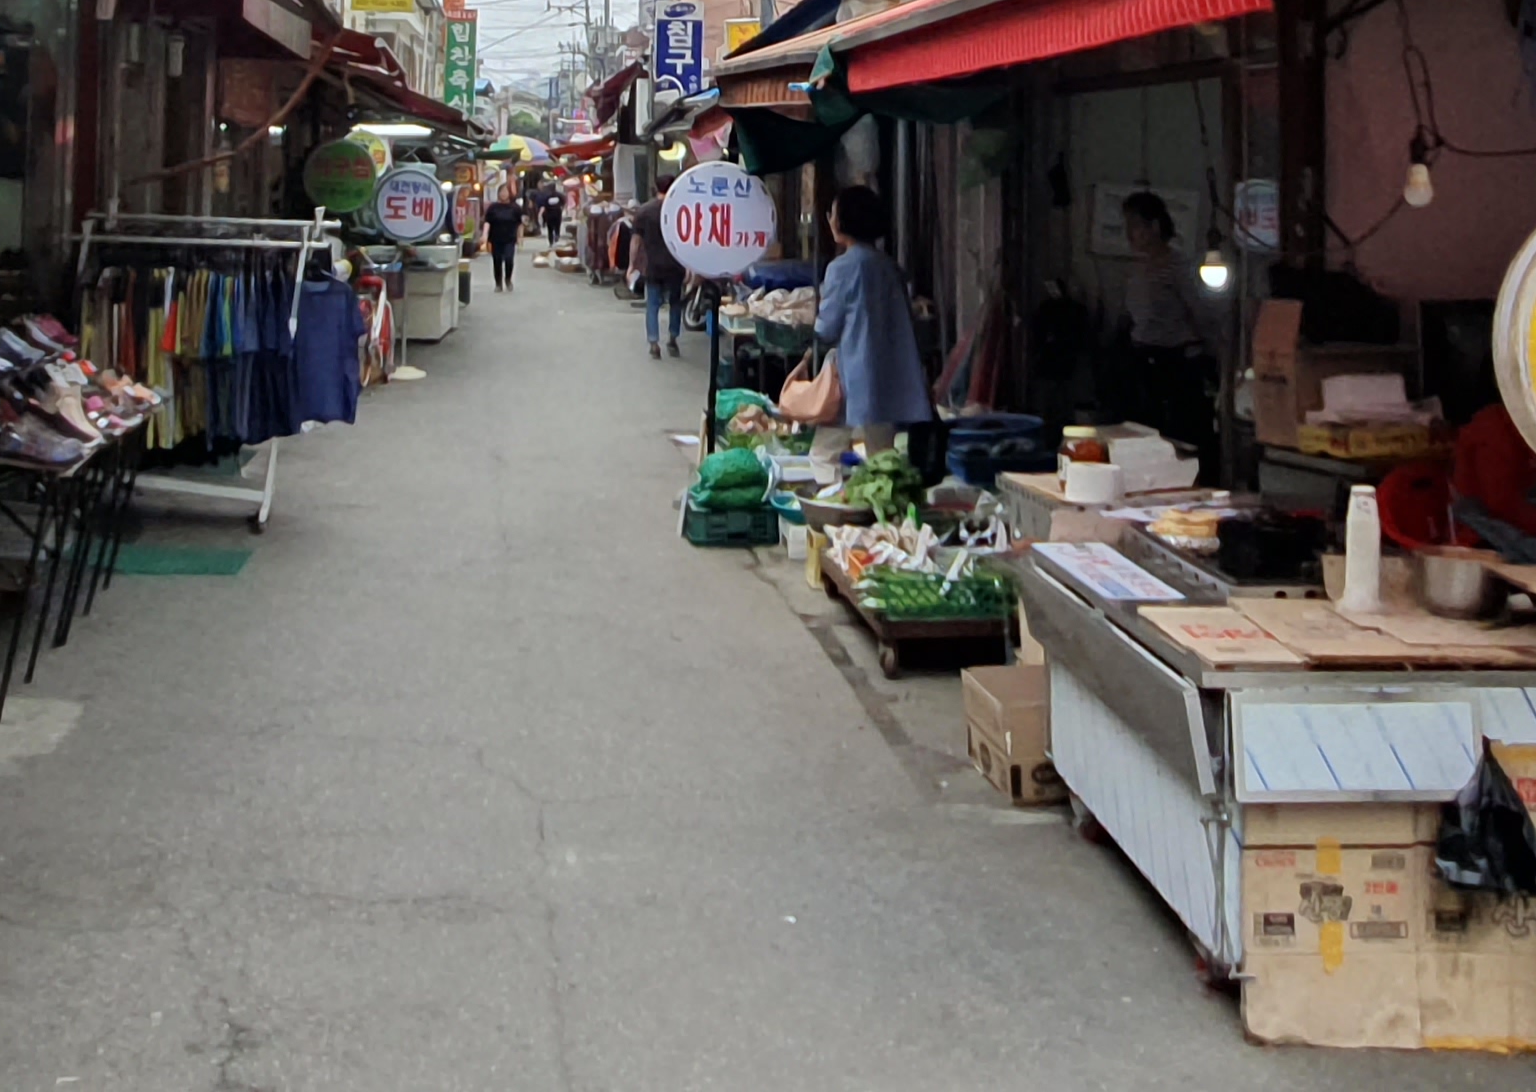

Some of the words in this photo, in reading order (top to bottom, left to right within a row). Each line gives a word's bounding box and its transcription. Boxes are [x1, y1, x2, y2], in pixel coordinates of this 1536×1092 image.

[664, 21, 695, 75] 침구
[384, 195, 434, 222] 도배
[676, 201, 732, 248] 야채
[736, 230, 767, 248] 가게
